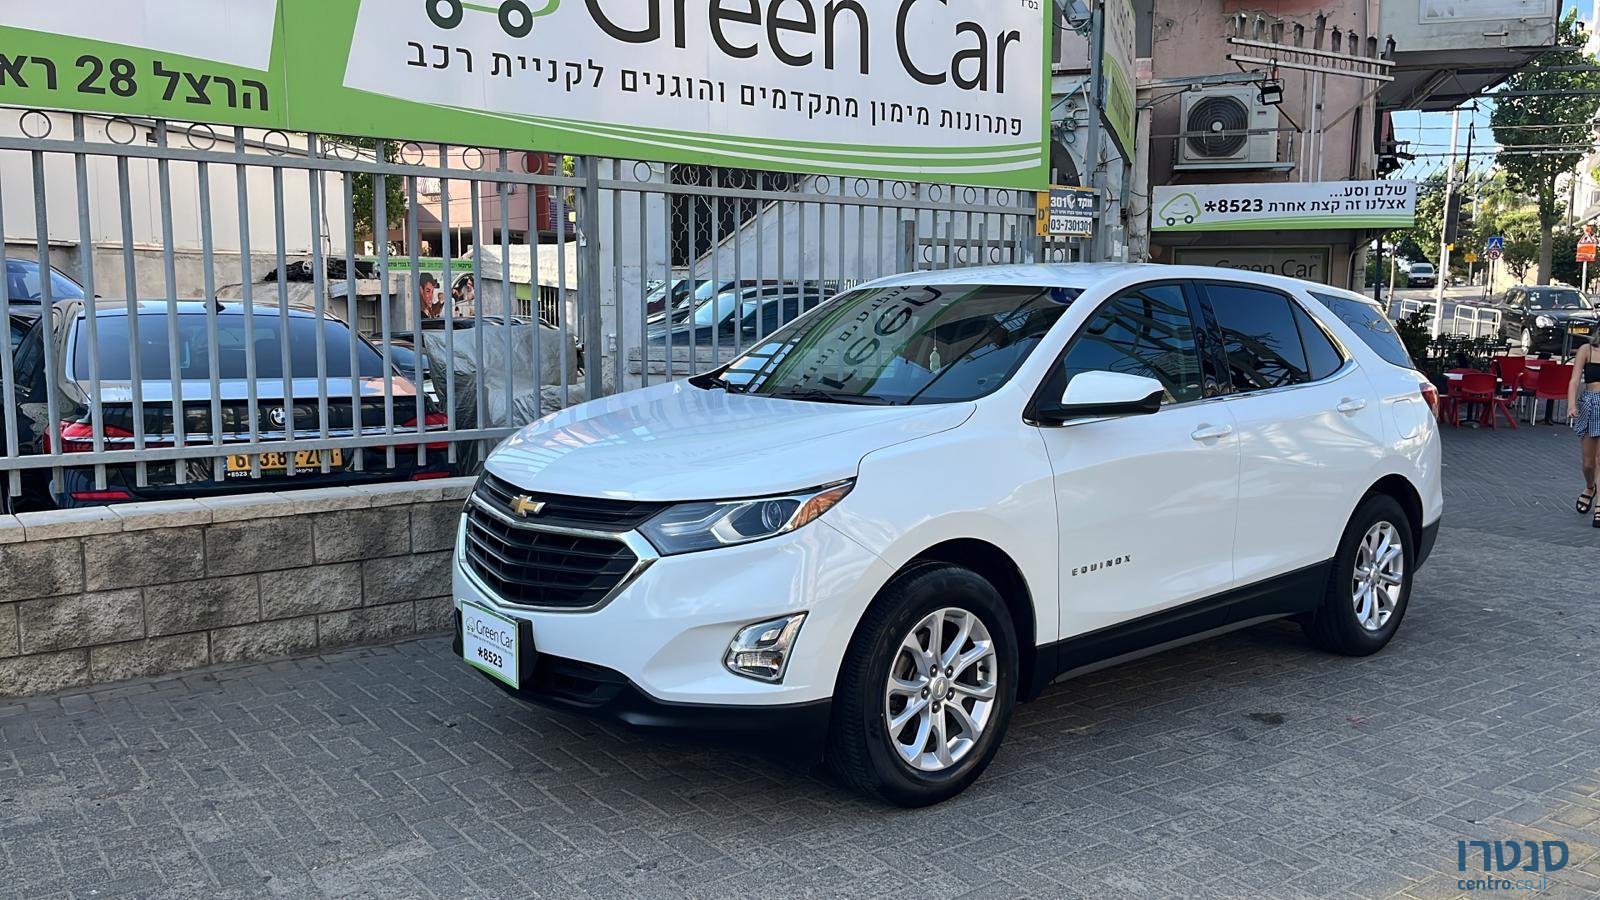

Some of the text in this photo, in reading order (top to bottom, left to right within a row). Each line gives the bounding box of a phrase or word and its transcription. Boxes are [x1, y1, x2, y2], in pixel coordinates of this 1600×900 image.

[896, 0, 1020, 94] Car
[75, 54, 138, 97] 28
[152, 60, 269, 111] הרצל
[407, 41, 1022, 136] פתרונות מימון מתקדמים והוגנים לקניית רכב
[1329, 185, 1407, 197] שלם וסע...
[1050, 197, 1067, 208] 301
[1268, 200, 1306, 212] אחרת
[1310, 199, 1340, 214] קצת
[1345, 200, 1360, 210] זה
[1366, 198, 1406, 209] אצלנו
[1281, 259, 1317, 278] Car
[1071, 554, 1131, 576] EQUINOX
[476, 619, 500, 643] Green
[501, 631, 514, 649] Car
